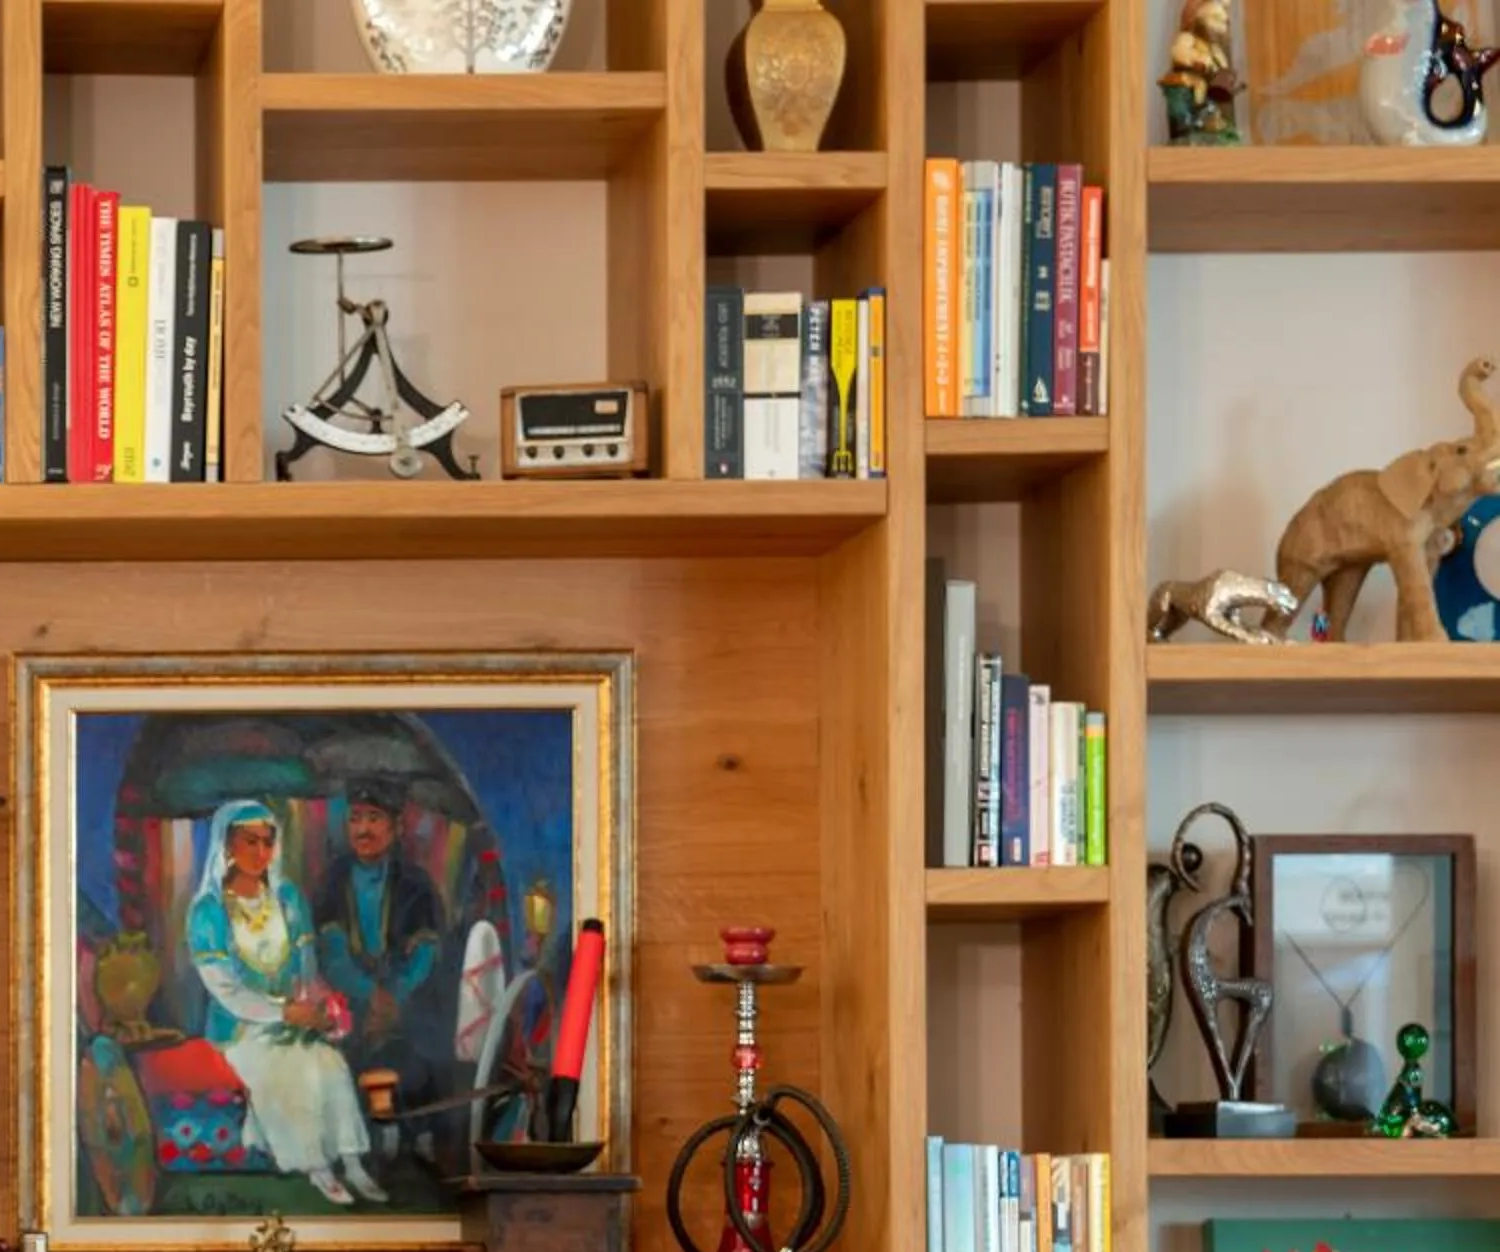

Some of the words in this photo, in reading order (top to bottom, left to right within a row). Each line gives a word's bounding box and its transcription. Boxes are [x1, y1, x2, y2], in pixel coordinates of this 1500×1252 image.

[99, 200, 111, 229] THE
[99, 232, 111, 277] TIMES
[99, 283, 111, 328] ATLAS
[99, 331, 110, 350] OF
[809, 308, 822, 351] PETER
[98, 355, 110, 383] THE
[98, 388, 110, 439] WORLD
